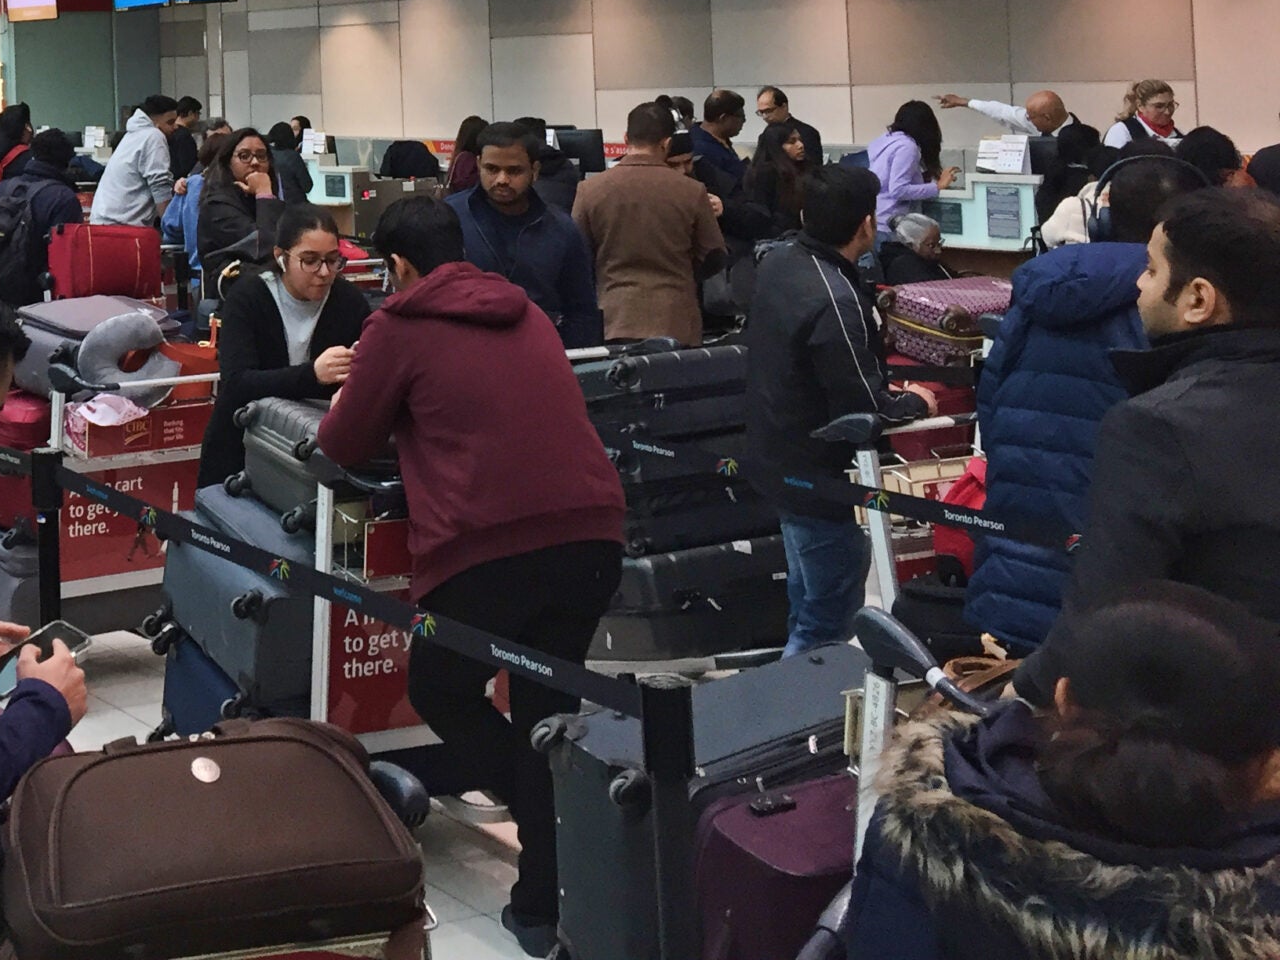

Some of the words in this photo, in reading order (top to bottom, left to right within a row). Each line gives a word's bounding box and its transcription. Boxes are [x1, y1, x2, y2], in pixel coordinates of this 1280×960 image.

[632, 440, 652, 454] Toronto
[653, 445, 675, 458] Pearson
[115, 476, 143, 492] cart
[69, 504, 84, 519] to
[944, 509, 972, 526] Toronto
[973, 514, 1005, 531] Pearson
[67, 521, 109, 538] there.
[191, 529, 210, 544] Toronto
[210, 536, 231, 552] Pearson
[344, 608, 359, 627] A
[343, 635, 363, 653] to
[368, 630, 399, 656] get
[343, 658, 398, 680] there.
[490, 643, 520, 665] Toronto
[521, 654, 553, 677] Pearson
